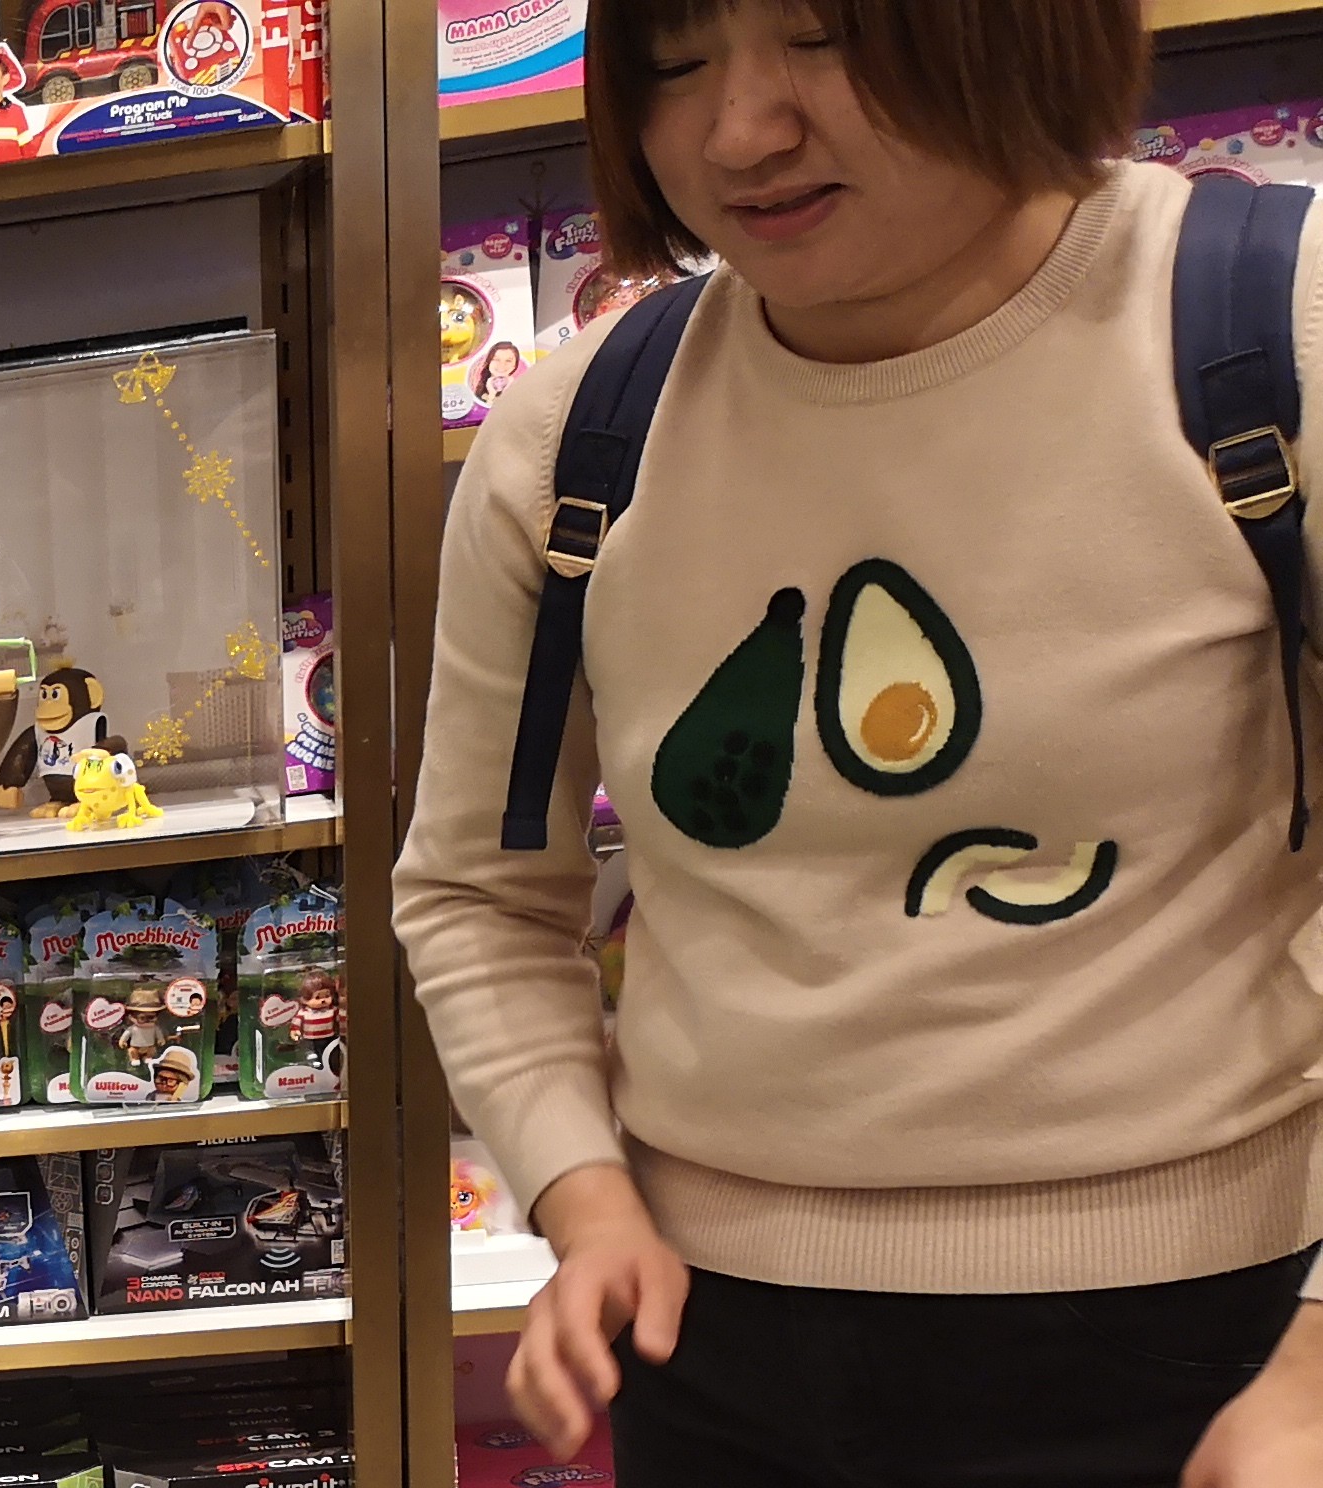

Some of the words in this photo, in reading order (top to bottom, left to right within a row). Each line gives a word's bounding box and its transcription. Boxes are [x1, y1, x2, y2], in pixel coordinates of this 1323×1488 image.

[450, 15, 506, 40] MAMA
[192, 86, 216, 97] 100+
[217, 55, 253, 92] COMMANDS
[110, 99, 166, 118] Program
[167, 96, 189, 109] Me
[124, 115, 144, 126] Fire
[145, 110, 173, 123] Truck
[560, 218, 596, 239] Tiny
[95, 926, 203, 958] Monchhichi
[95, 1080, 140, 1093] Willow
[277, 1073, 315, 1087] Kauri
[126, 1288, 184, 1304] NANO
[188, 1281, 266, 1300] FALCON
[270, 1279, 300, 1295] AH
[127, 1277, 140, 1290] 3
[197, 1431, 310, 1447] SPYCAM
[216, 1455, 334, 1473] SPYCAM
